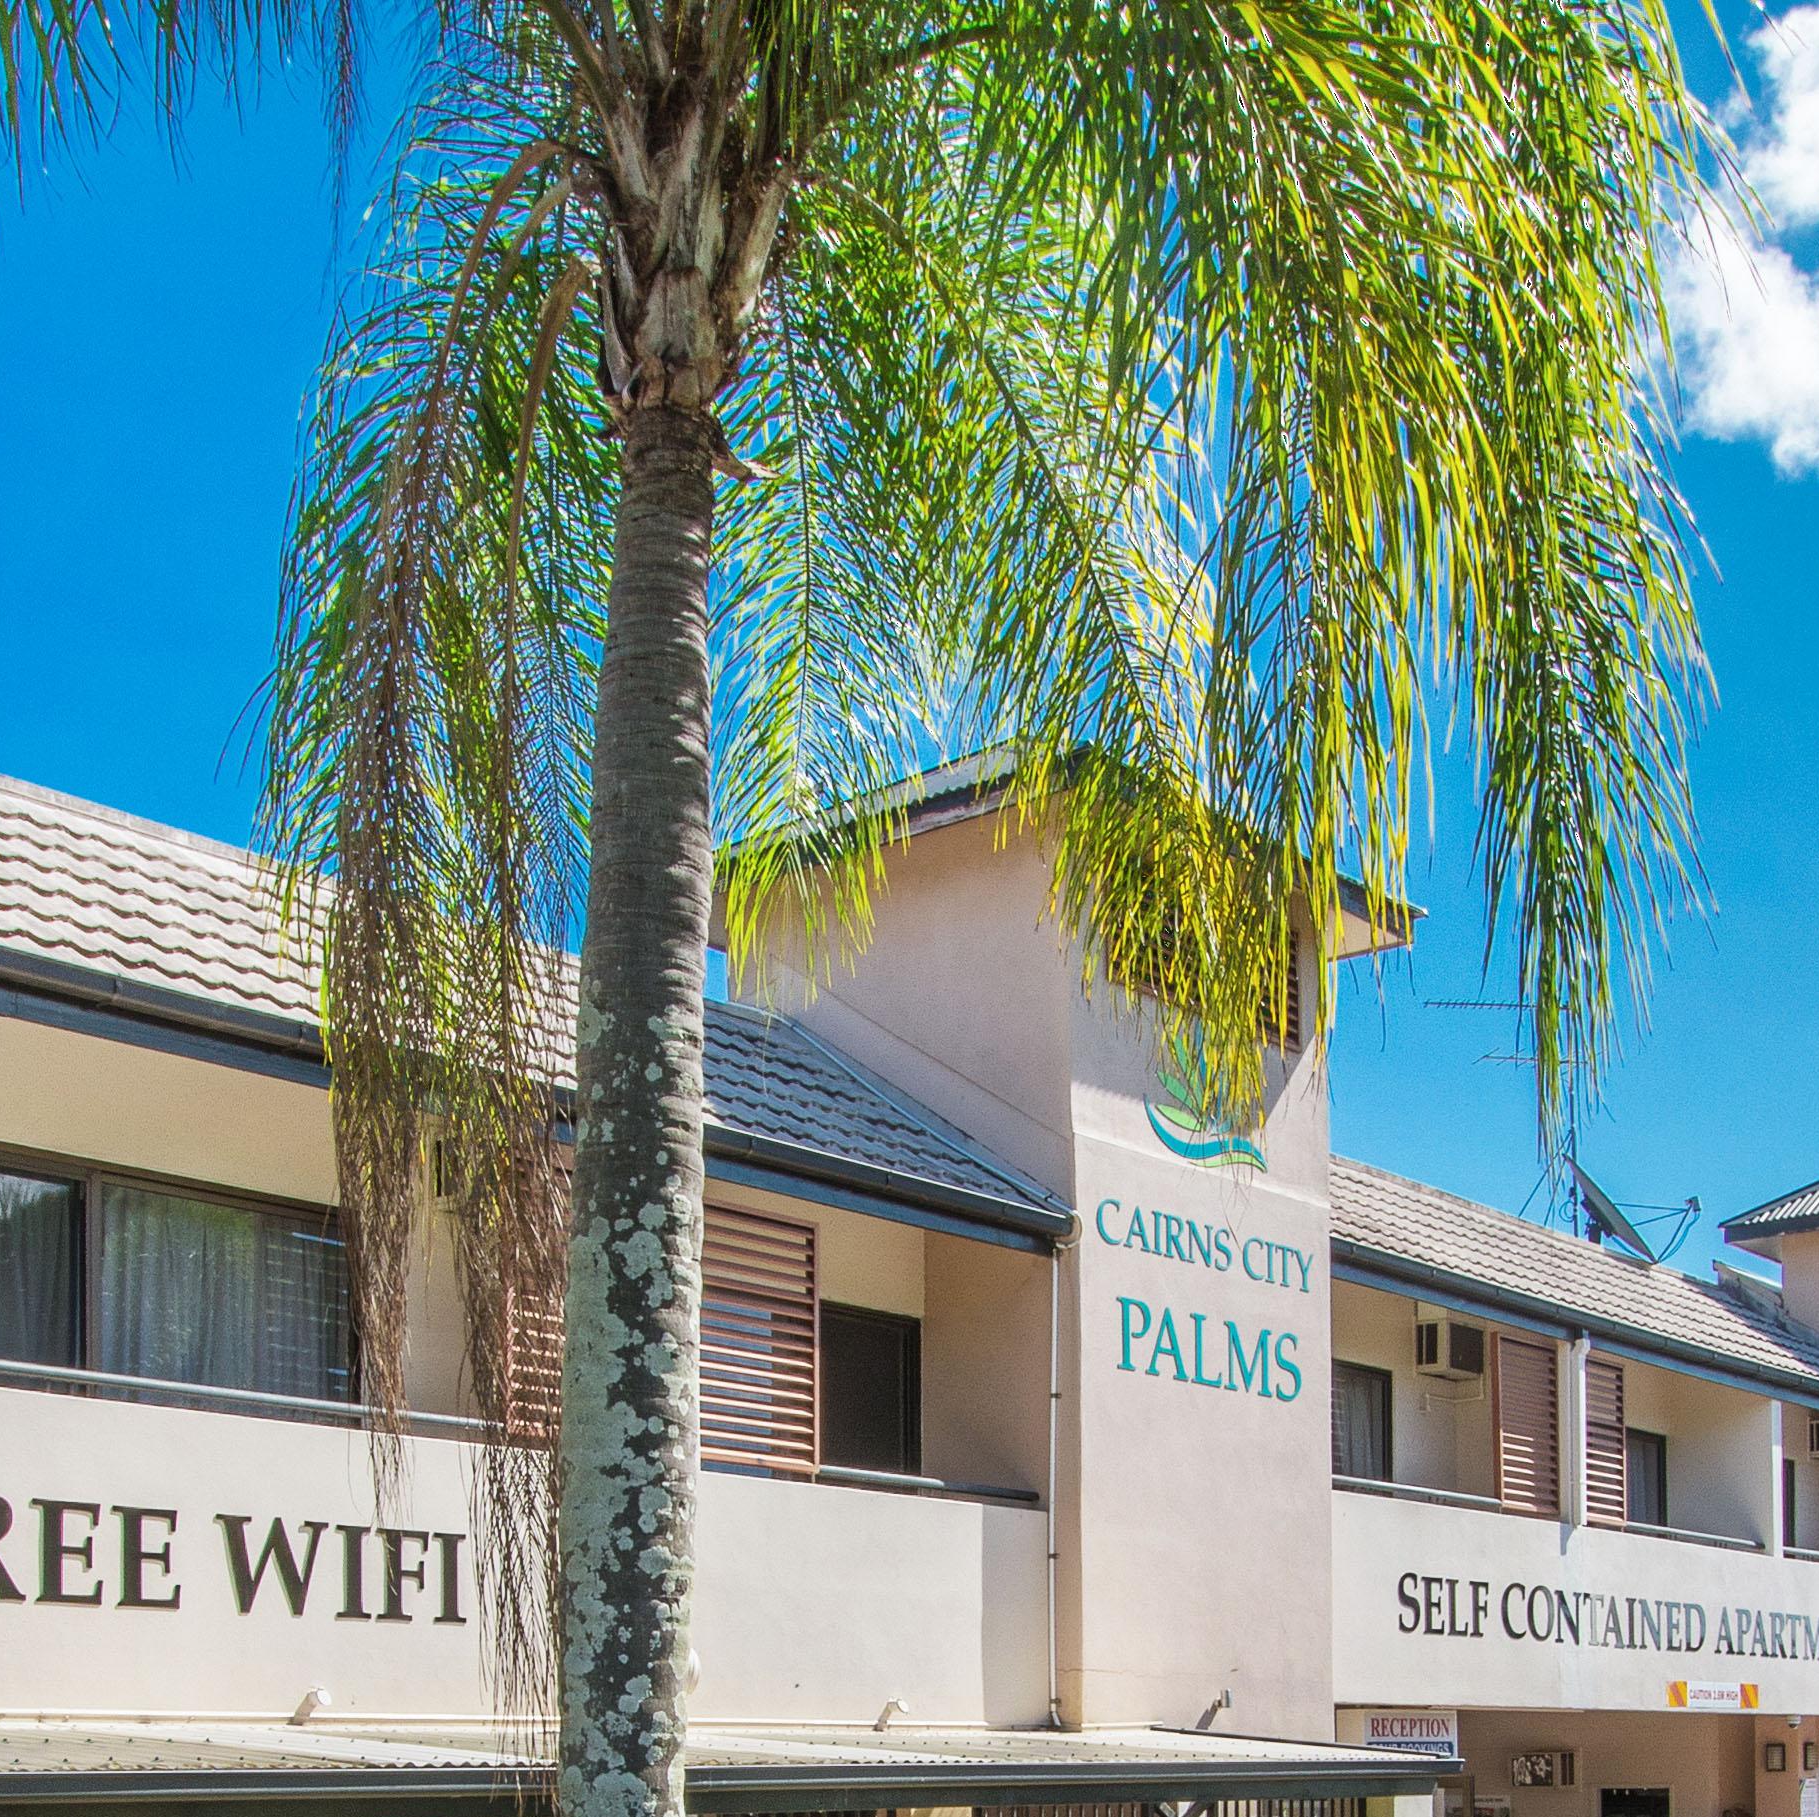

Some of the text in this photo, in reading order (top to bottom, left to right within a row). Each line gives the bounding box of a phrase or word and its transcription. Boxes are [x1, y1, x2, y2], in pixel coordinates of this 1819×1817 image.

[1095, 1198, 1314, 1293] CAIRNS CITY
[1116, 1295, 1303, 1402] PALMS
[213, 1512, 467, 1624] WIFI
[1397, 1572, 1489, 1638] SELF
[1501, 1582, 1707, 1653] CONTAINED
[1370, 1717, 1451, 1738] RECEPTION
